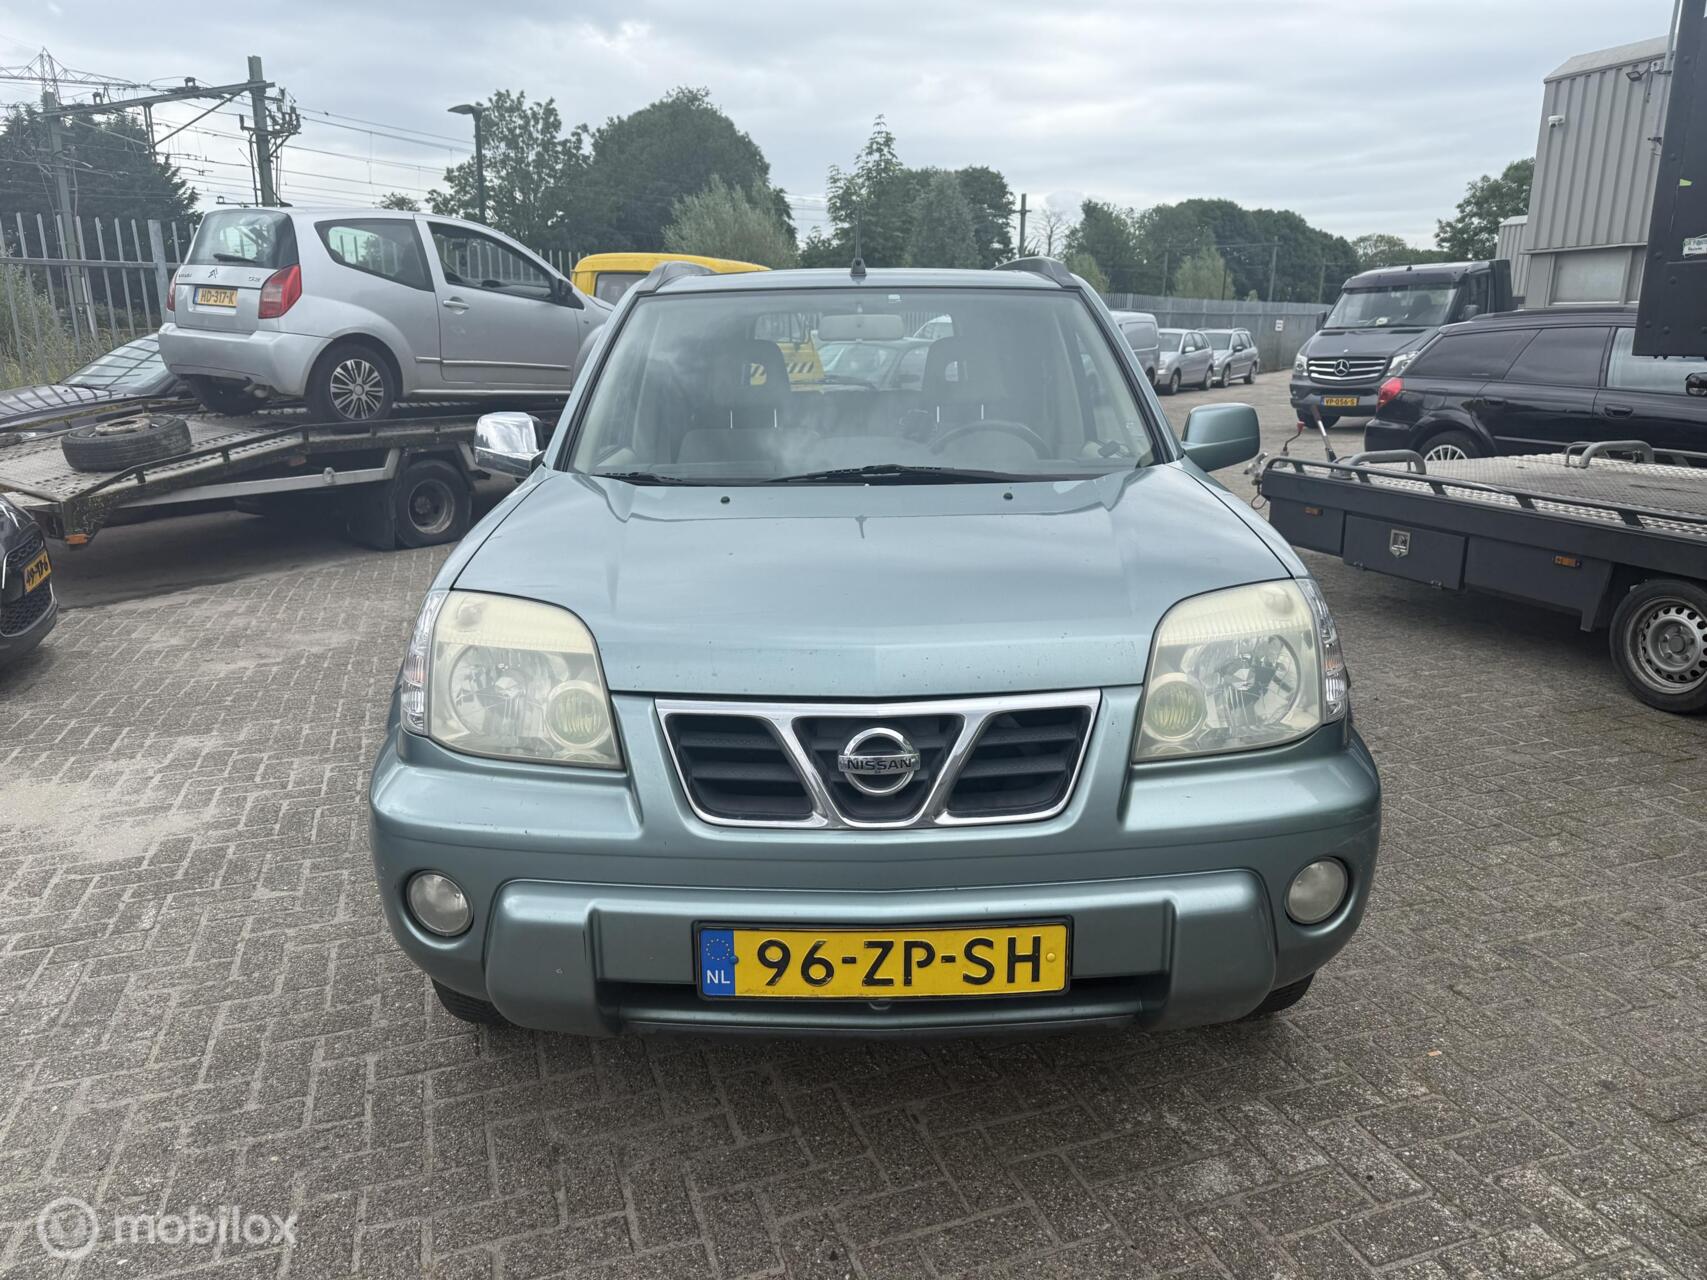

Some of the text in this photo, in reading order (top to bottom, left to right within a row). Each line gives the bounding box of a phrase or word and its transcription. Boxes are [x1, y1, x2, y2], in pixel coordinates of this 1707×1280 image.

[847, 758, 912, 770] NISSAN
[706, 935, 1042, 987] NL 96-ZP-SH
